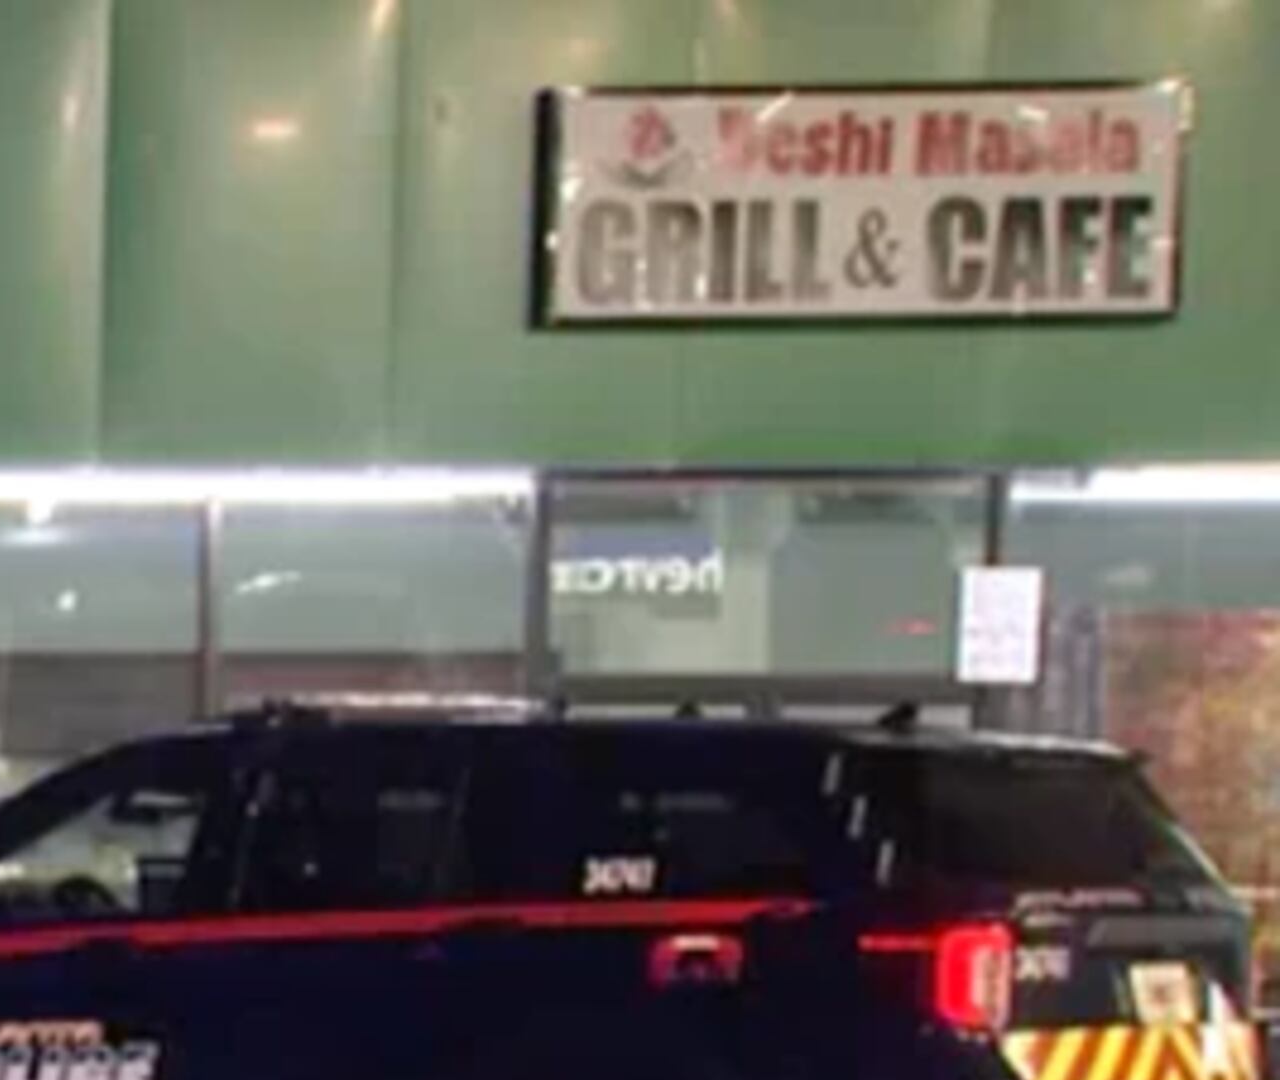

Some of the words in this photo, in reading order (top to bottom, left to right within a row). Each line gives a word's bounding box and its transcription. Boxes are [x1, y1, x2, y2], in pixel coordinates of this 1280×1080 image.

[576, 199, 828, 303] GRILL
[844, 206, 900, 289] &
[928, 196, 1153, 300] CAFE
